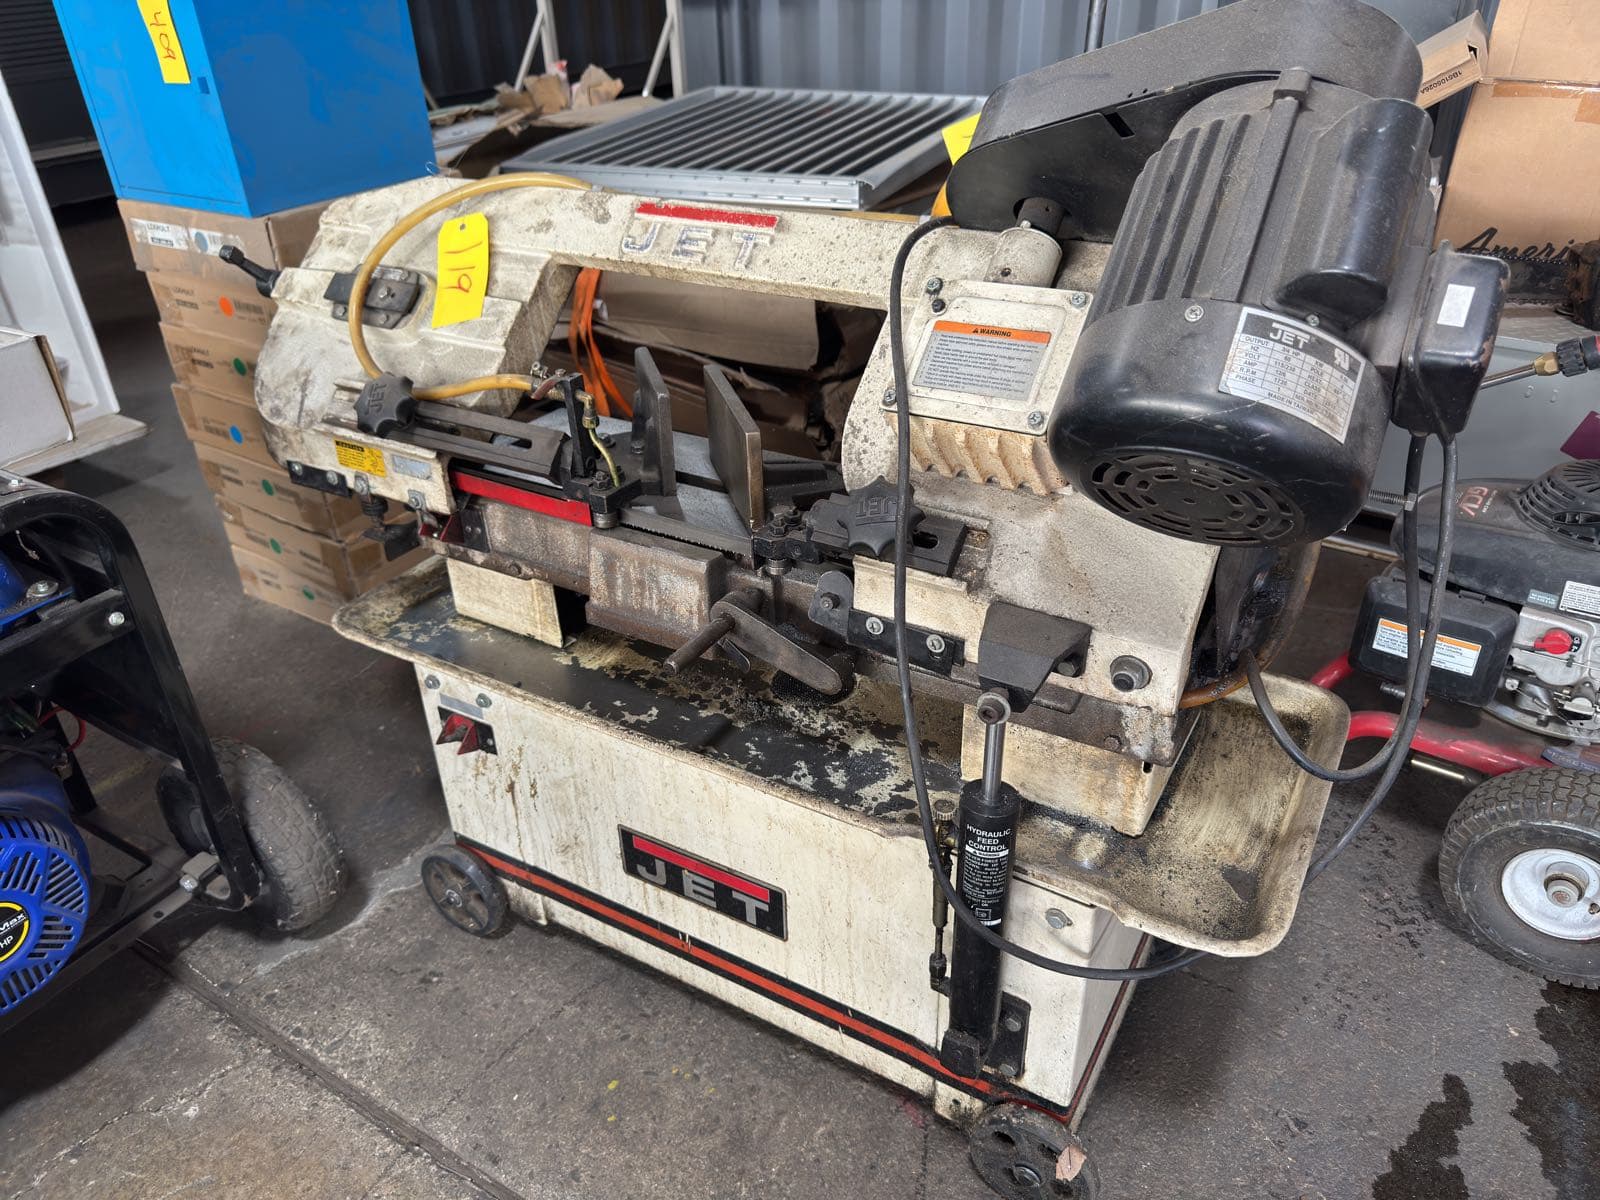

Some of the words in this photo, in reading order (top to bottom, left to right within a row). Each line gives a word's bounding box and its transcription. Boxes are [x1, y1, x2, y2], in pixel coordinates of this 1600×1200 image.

[150, 11, 176, 60] 409
[622, 221, 775, 270] JET
[440, 241, 483, 294] 119
[979, 328, 1012, 338] WARNING
[1269, 325, 1310, 349] JET
[1460, 486, 1488, 517] GCV
[966, 823, 1011, 838] HYDRAULIC
[977, 836, 999, 845] FEED
[968, 840, 1006, 852] CONTROL
[636, 857, 770, 926] JET
[0, 935, 14, 949] HP
